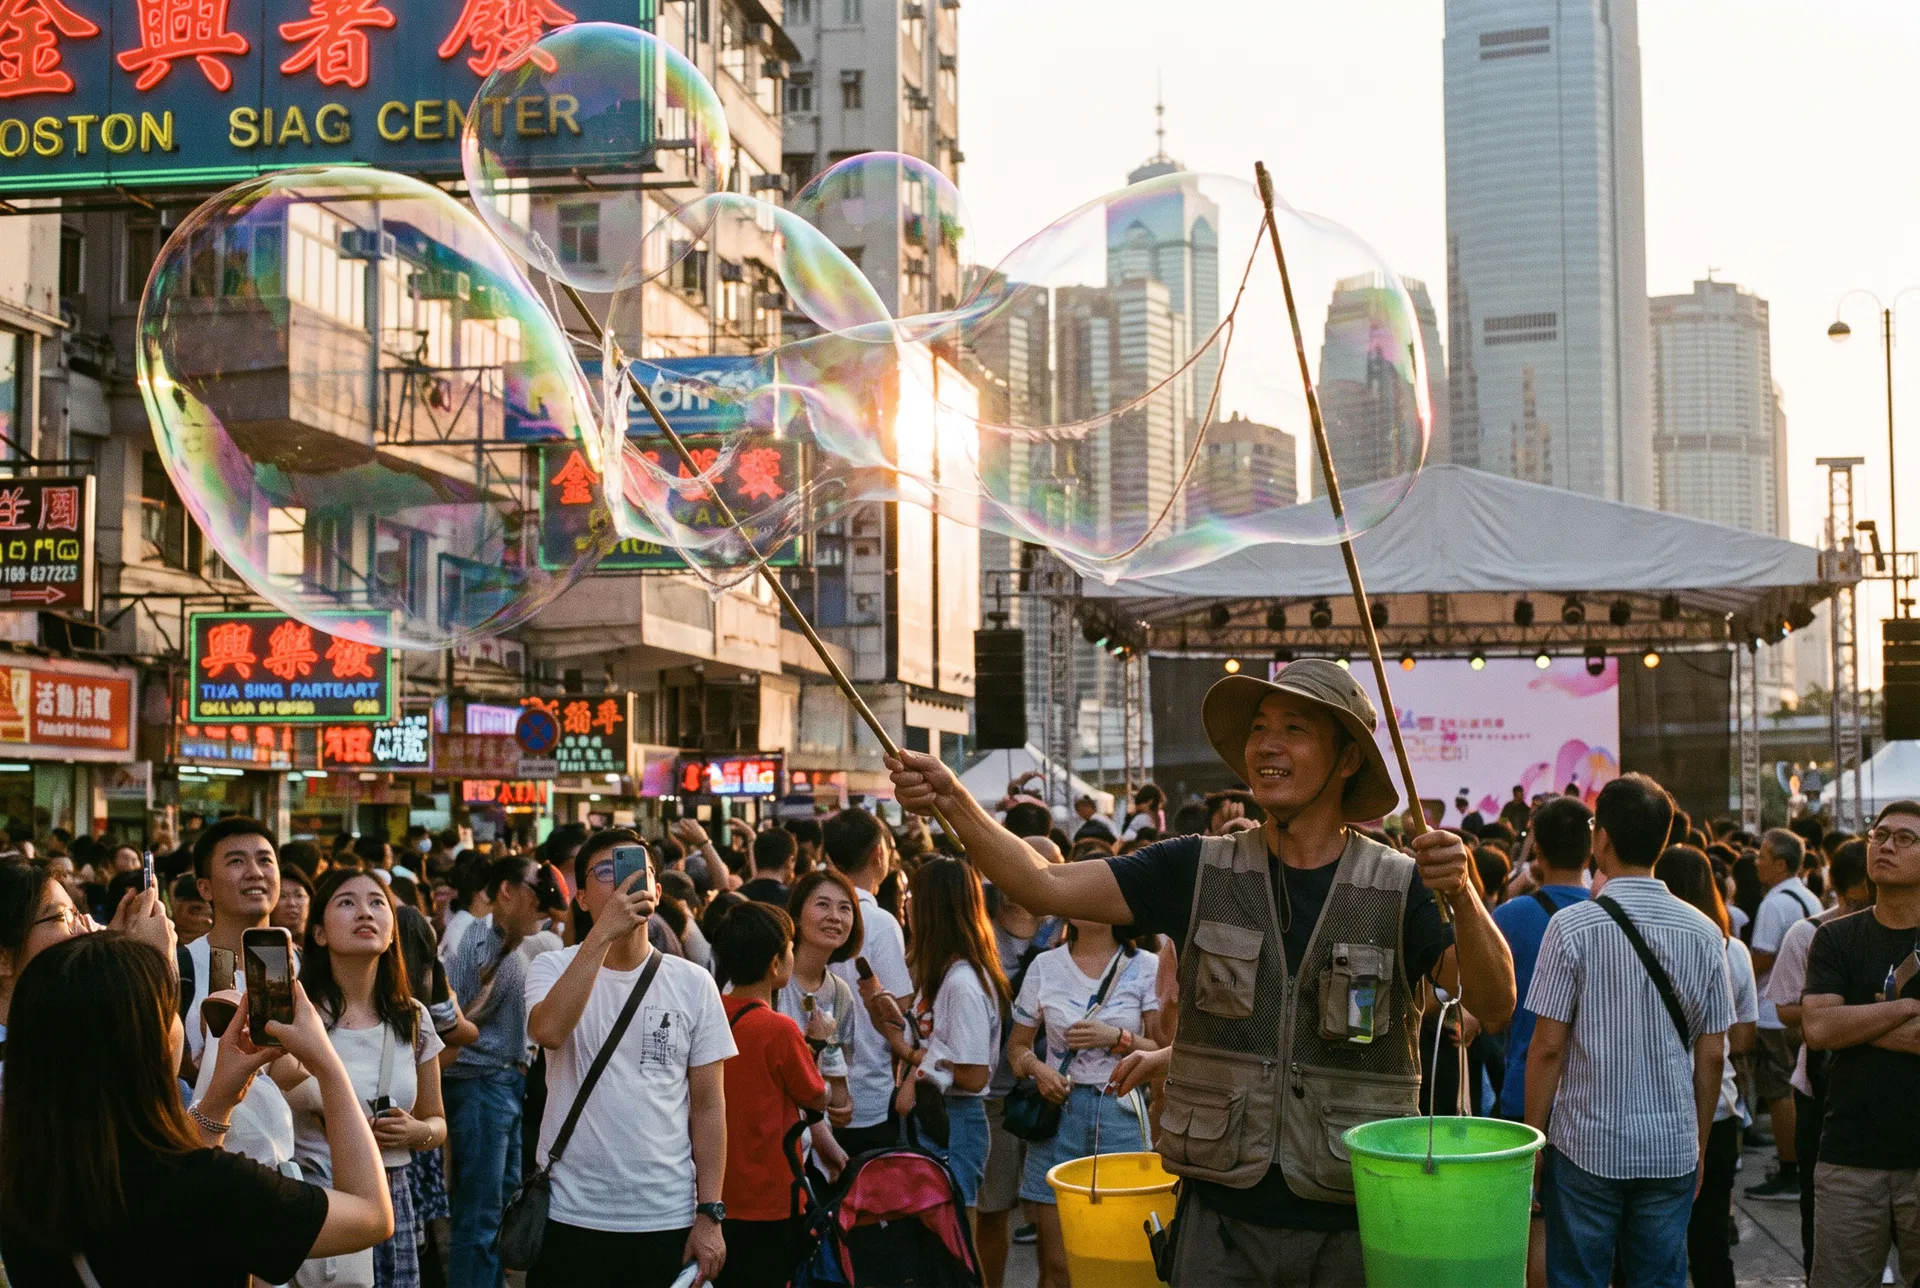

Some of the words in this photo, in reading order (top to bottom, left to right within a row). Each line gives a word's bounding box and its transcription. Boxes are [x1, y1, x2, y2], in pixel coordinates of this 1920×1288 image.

[0, 111, 174, 158] OSTON
[229, 103, 350, 148] SIAG
[377, 94, 582, 142] CENTER
